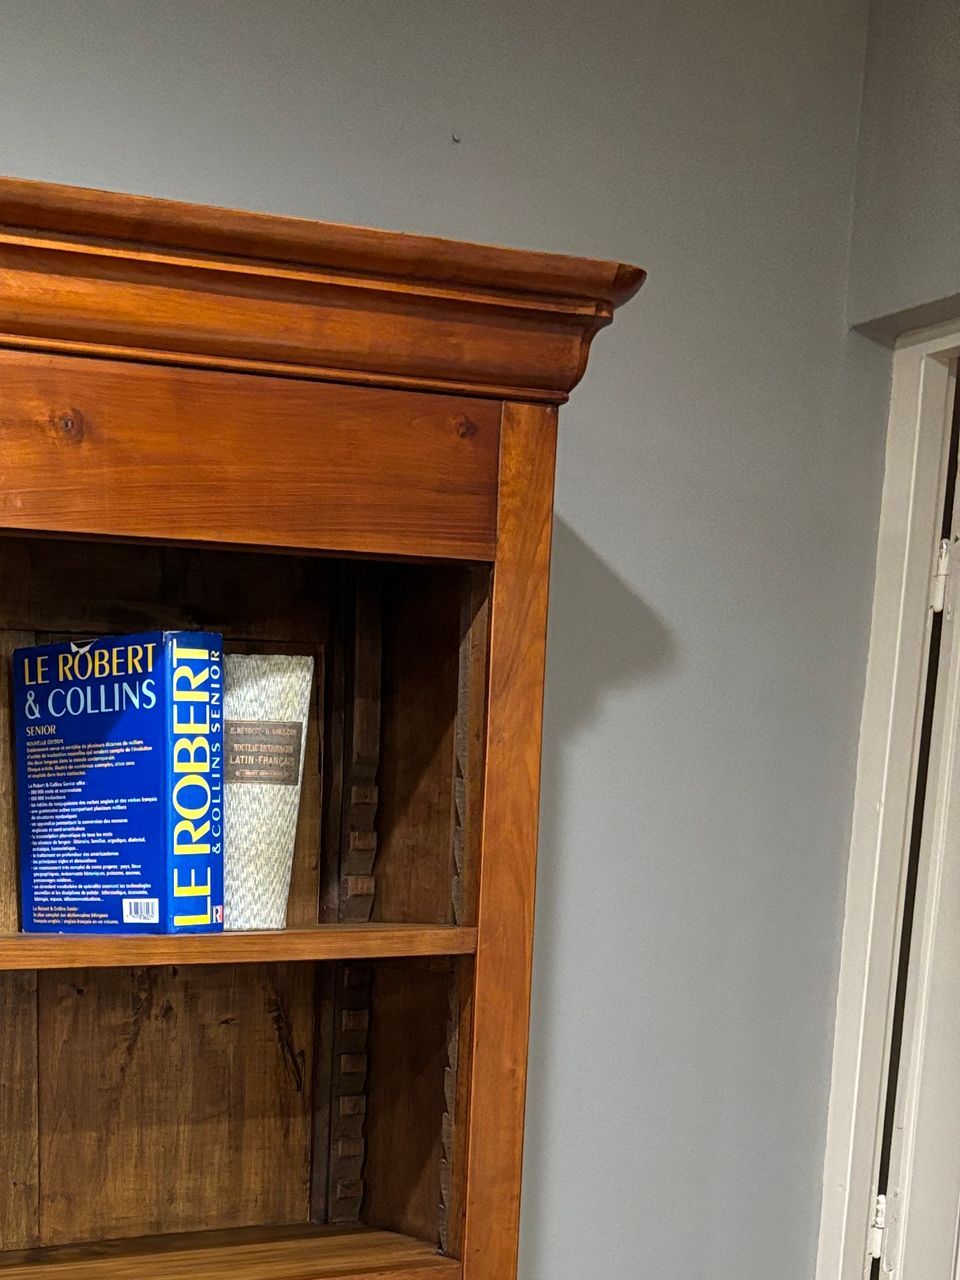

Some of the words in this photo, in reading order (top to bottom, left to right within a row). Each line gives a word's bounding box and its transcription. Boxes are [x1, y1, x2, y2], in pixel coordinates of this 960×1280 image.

[24, 655, 50, 685] LE
[58, 643, 157, 682] ROBERT
[24, 690, 41, 720] &
[47, 679, 157, 717] COLLINS
[210, 650, 221, 733] SENIOR
[26, 724, 57, 737] SENIOR
[171, 638, 211, 855] ROBERT
[211, 742, 222, 838] COLLINS
[211, 842, 222, 855] &
[172, 866, 211, 927] LE
